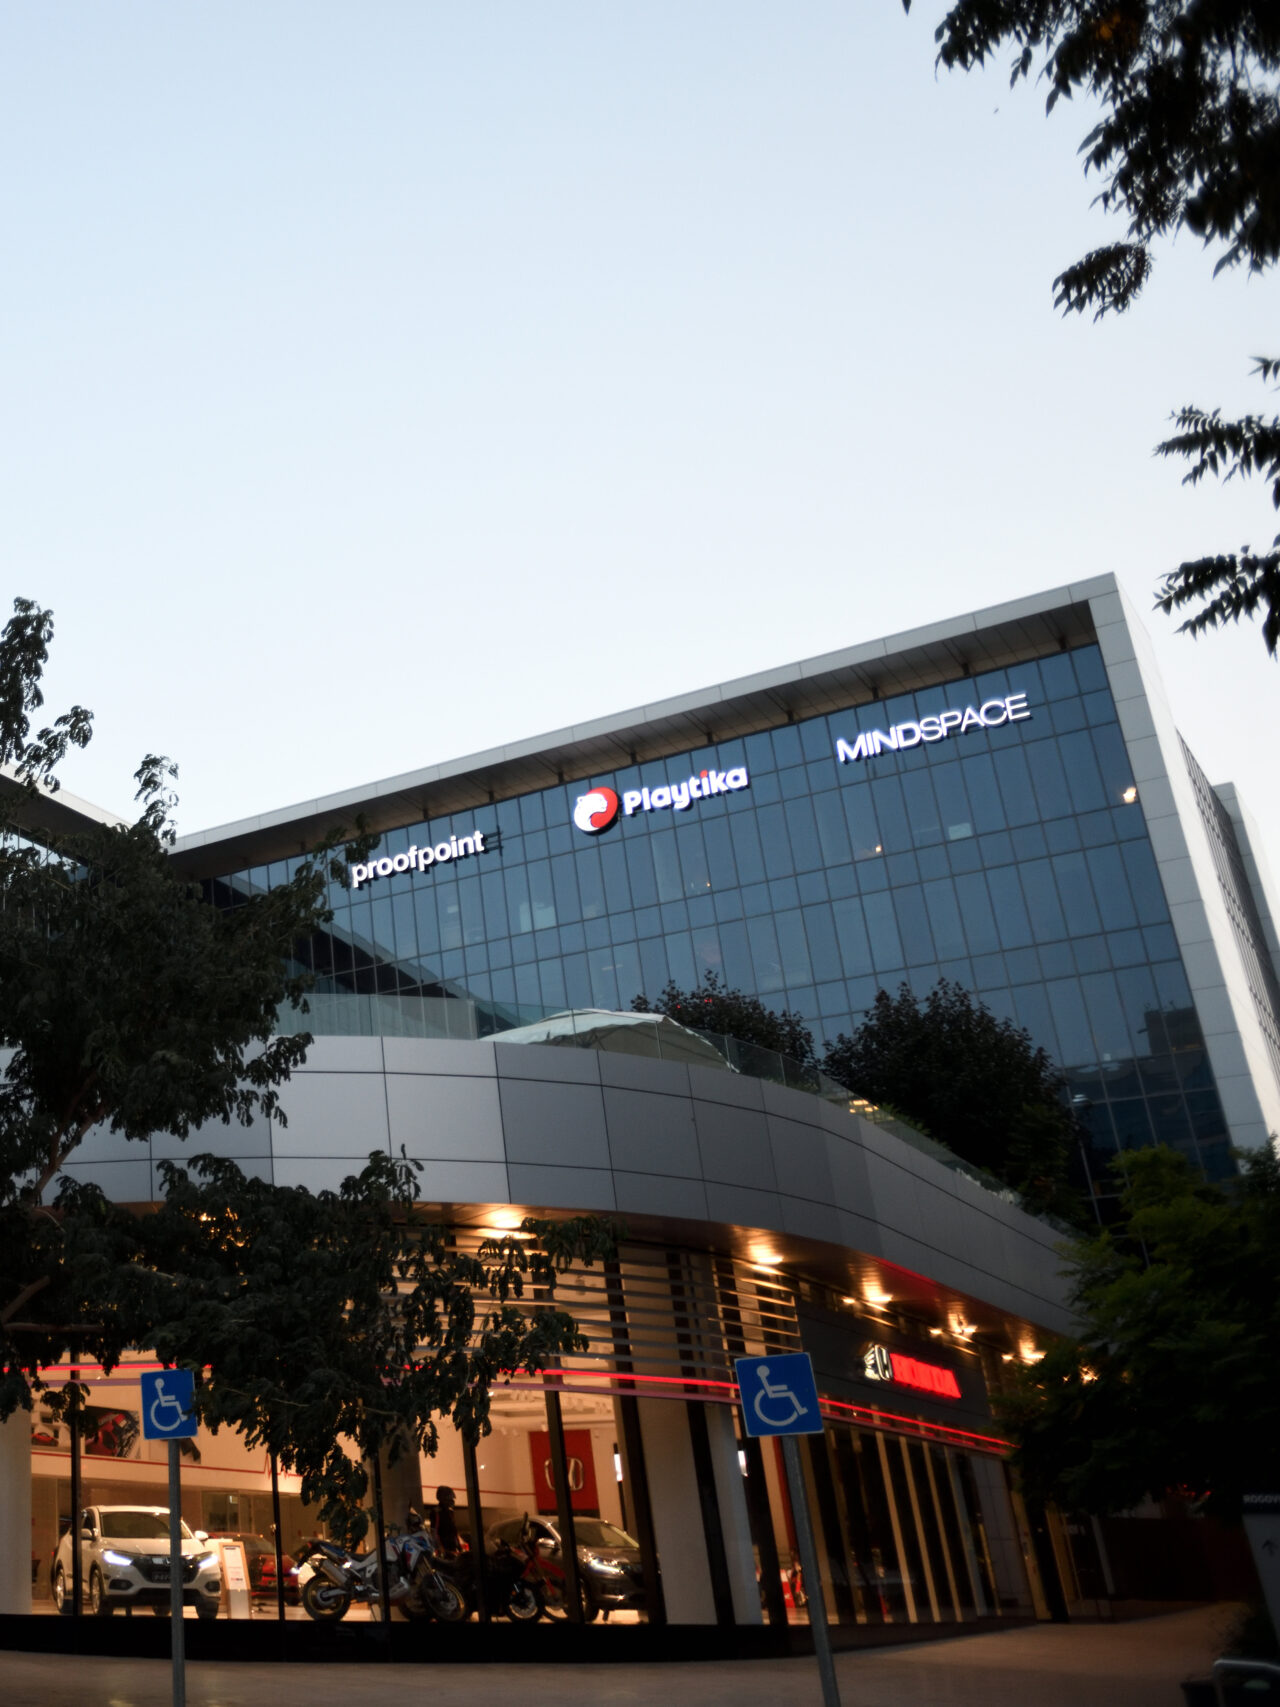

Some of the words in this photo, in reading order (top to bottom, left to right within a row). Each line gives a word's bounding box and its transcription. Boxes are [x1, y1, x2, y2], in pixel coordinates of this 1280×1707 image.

[835, 692, 1032, 763] MINDSPACE
[622, 767, 749, 816] Playtika
[351, 830, 486, 888] proofpoint
[889, 1353, 962, 1399] HONDA
[1242, 1494, 1280, 1505] ROGOV
